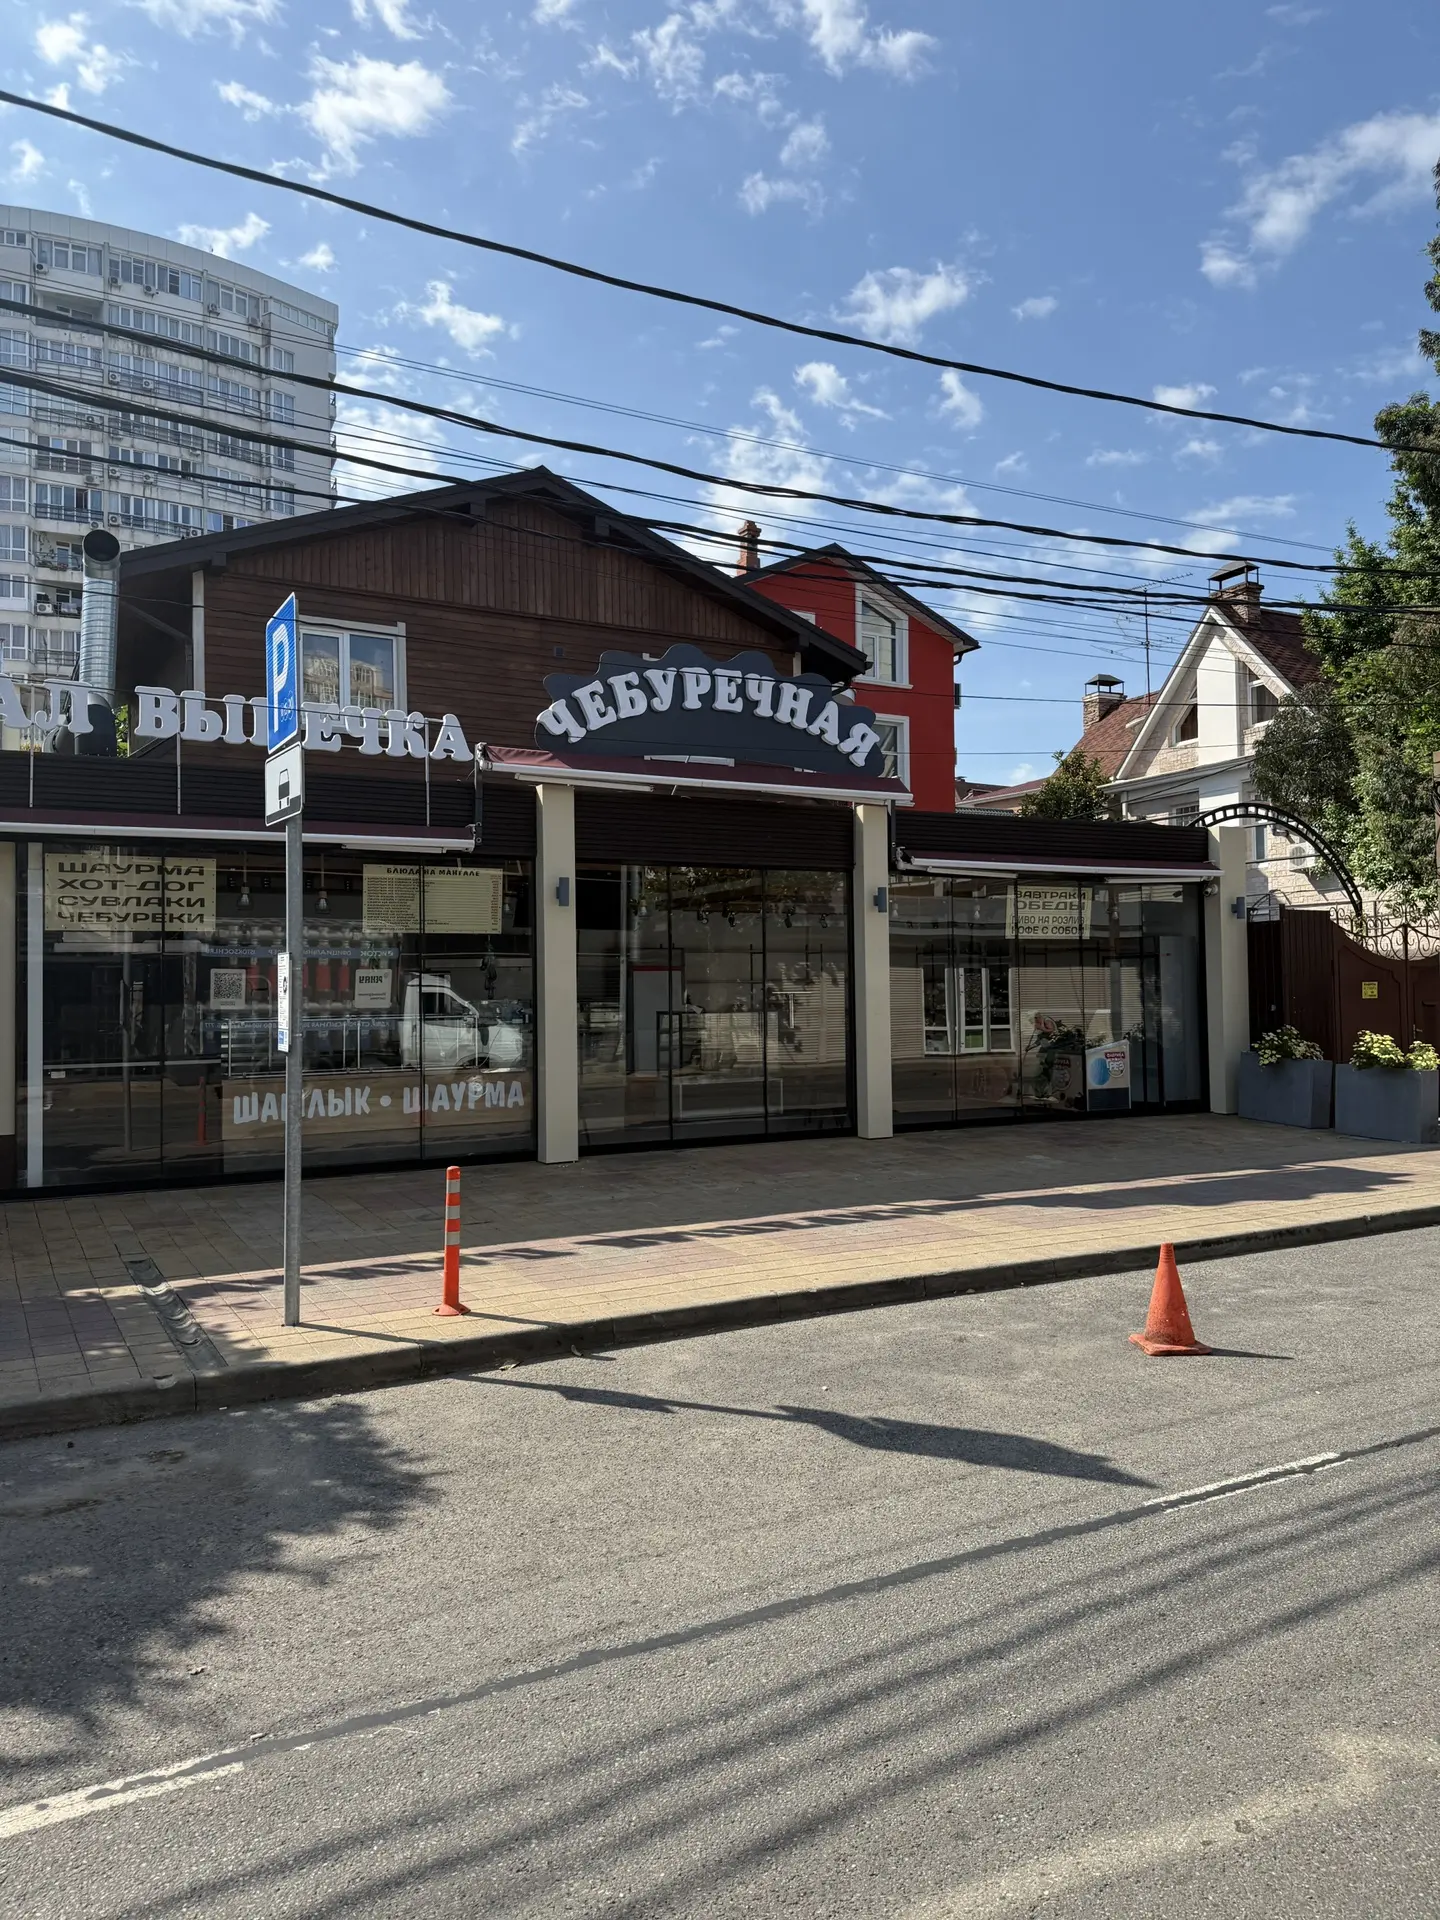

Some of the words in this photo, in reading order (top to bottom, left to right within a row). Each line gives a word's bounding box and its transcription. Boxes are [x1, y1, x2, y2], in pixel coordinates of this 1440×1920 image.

[272, 623, 290, 734] P
[536, 667, 880, 767] ЧЕБУРЕЧНАЯ
[58, 862, 205, 875] ШАУРМА
[386, 867, 421, 876] БЛЮДА
[57, 878, 205, 891] ХОТ-ДОГ
[1016, 890, 1085, 899] ЗАВТРАКИ
[57, 895, 205, 907] СУВЛАКИ
[1016, 901, 1085, 910] ОБЕДЫ
[57, 911, 205, 923] ЧЕБУРЕКИ
[1038, 916, 1050, 924] НА
[1041, 926, 1049, 934] С
[233, 1086, 371, 1125] ШАЛЫК
[403, 1080, 525, 1114] ШАУРМА
